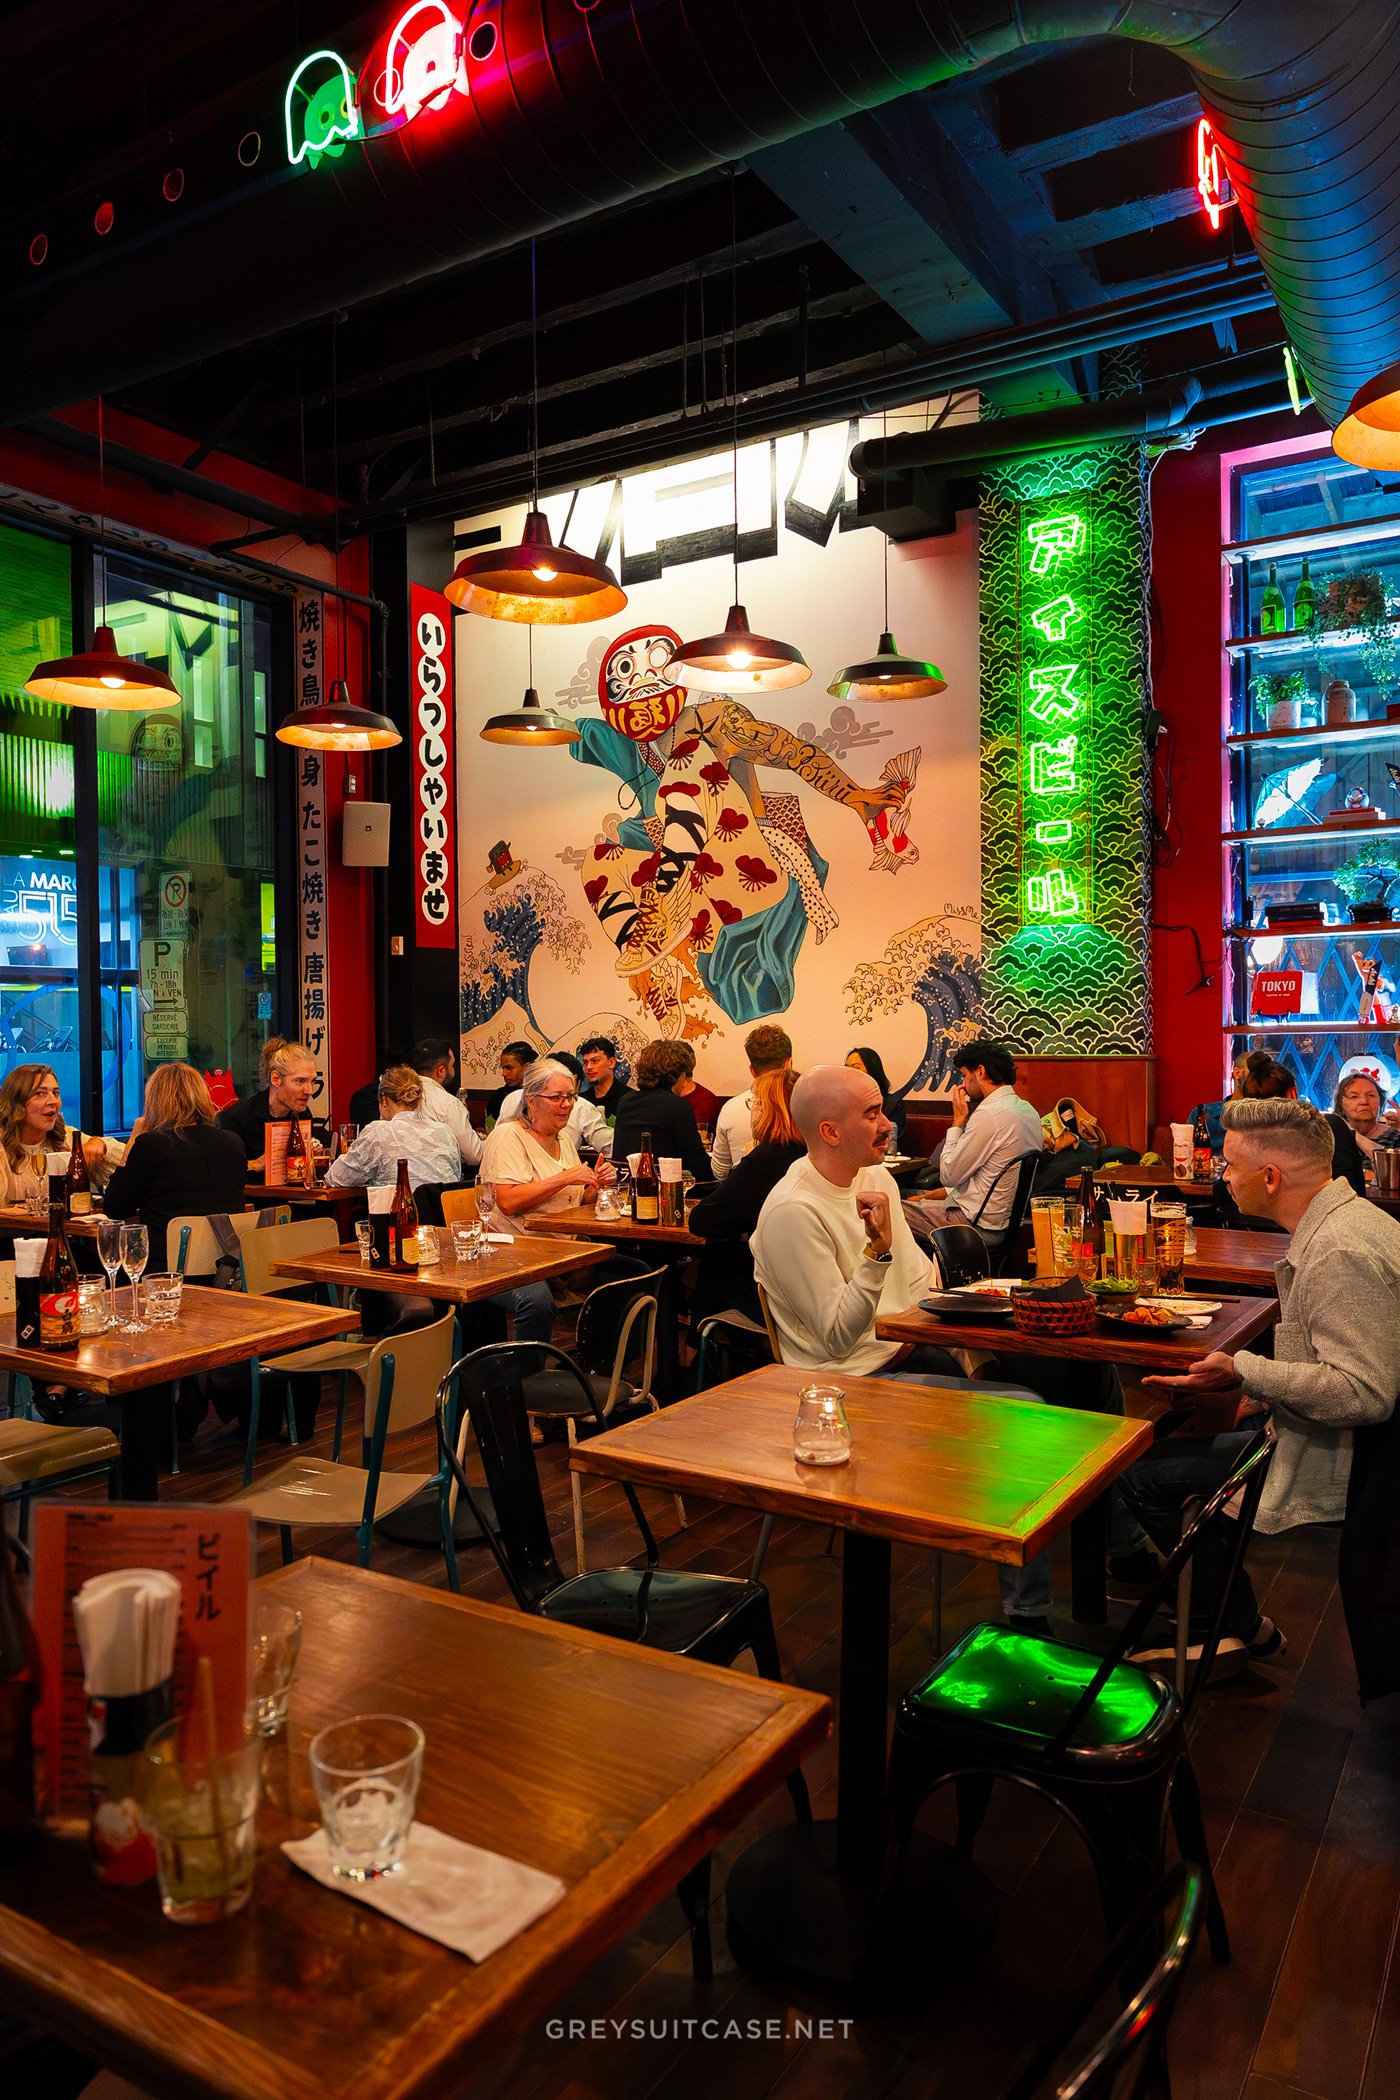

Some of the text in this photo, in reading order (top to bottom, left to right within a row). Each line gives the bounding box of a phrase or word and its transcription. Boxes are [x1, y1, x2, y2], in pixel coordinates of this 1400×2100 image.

[154, 941, 171, 967] P
[146, 968, 179, 980] 15 min
[1261, 980, 1296, 992] TOKYO
